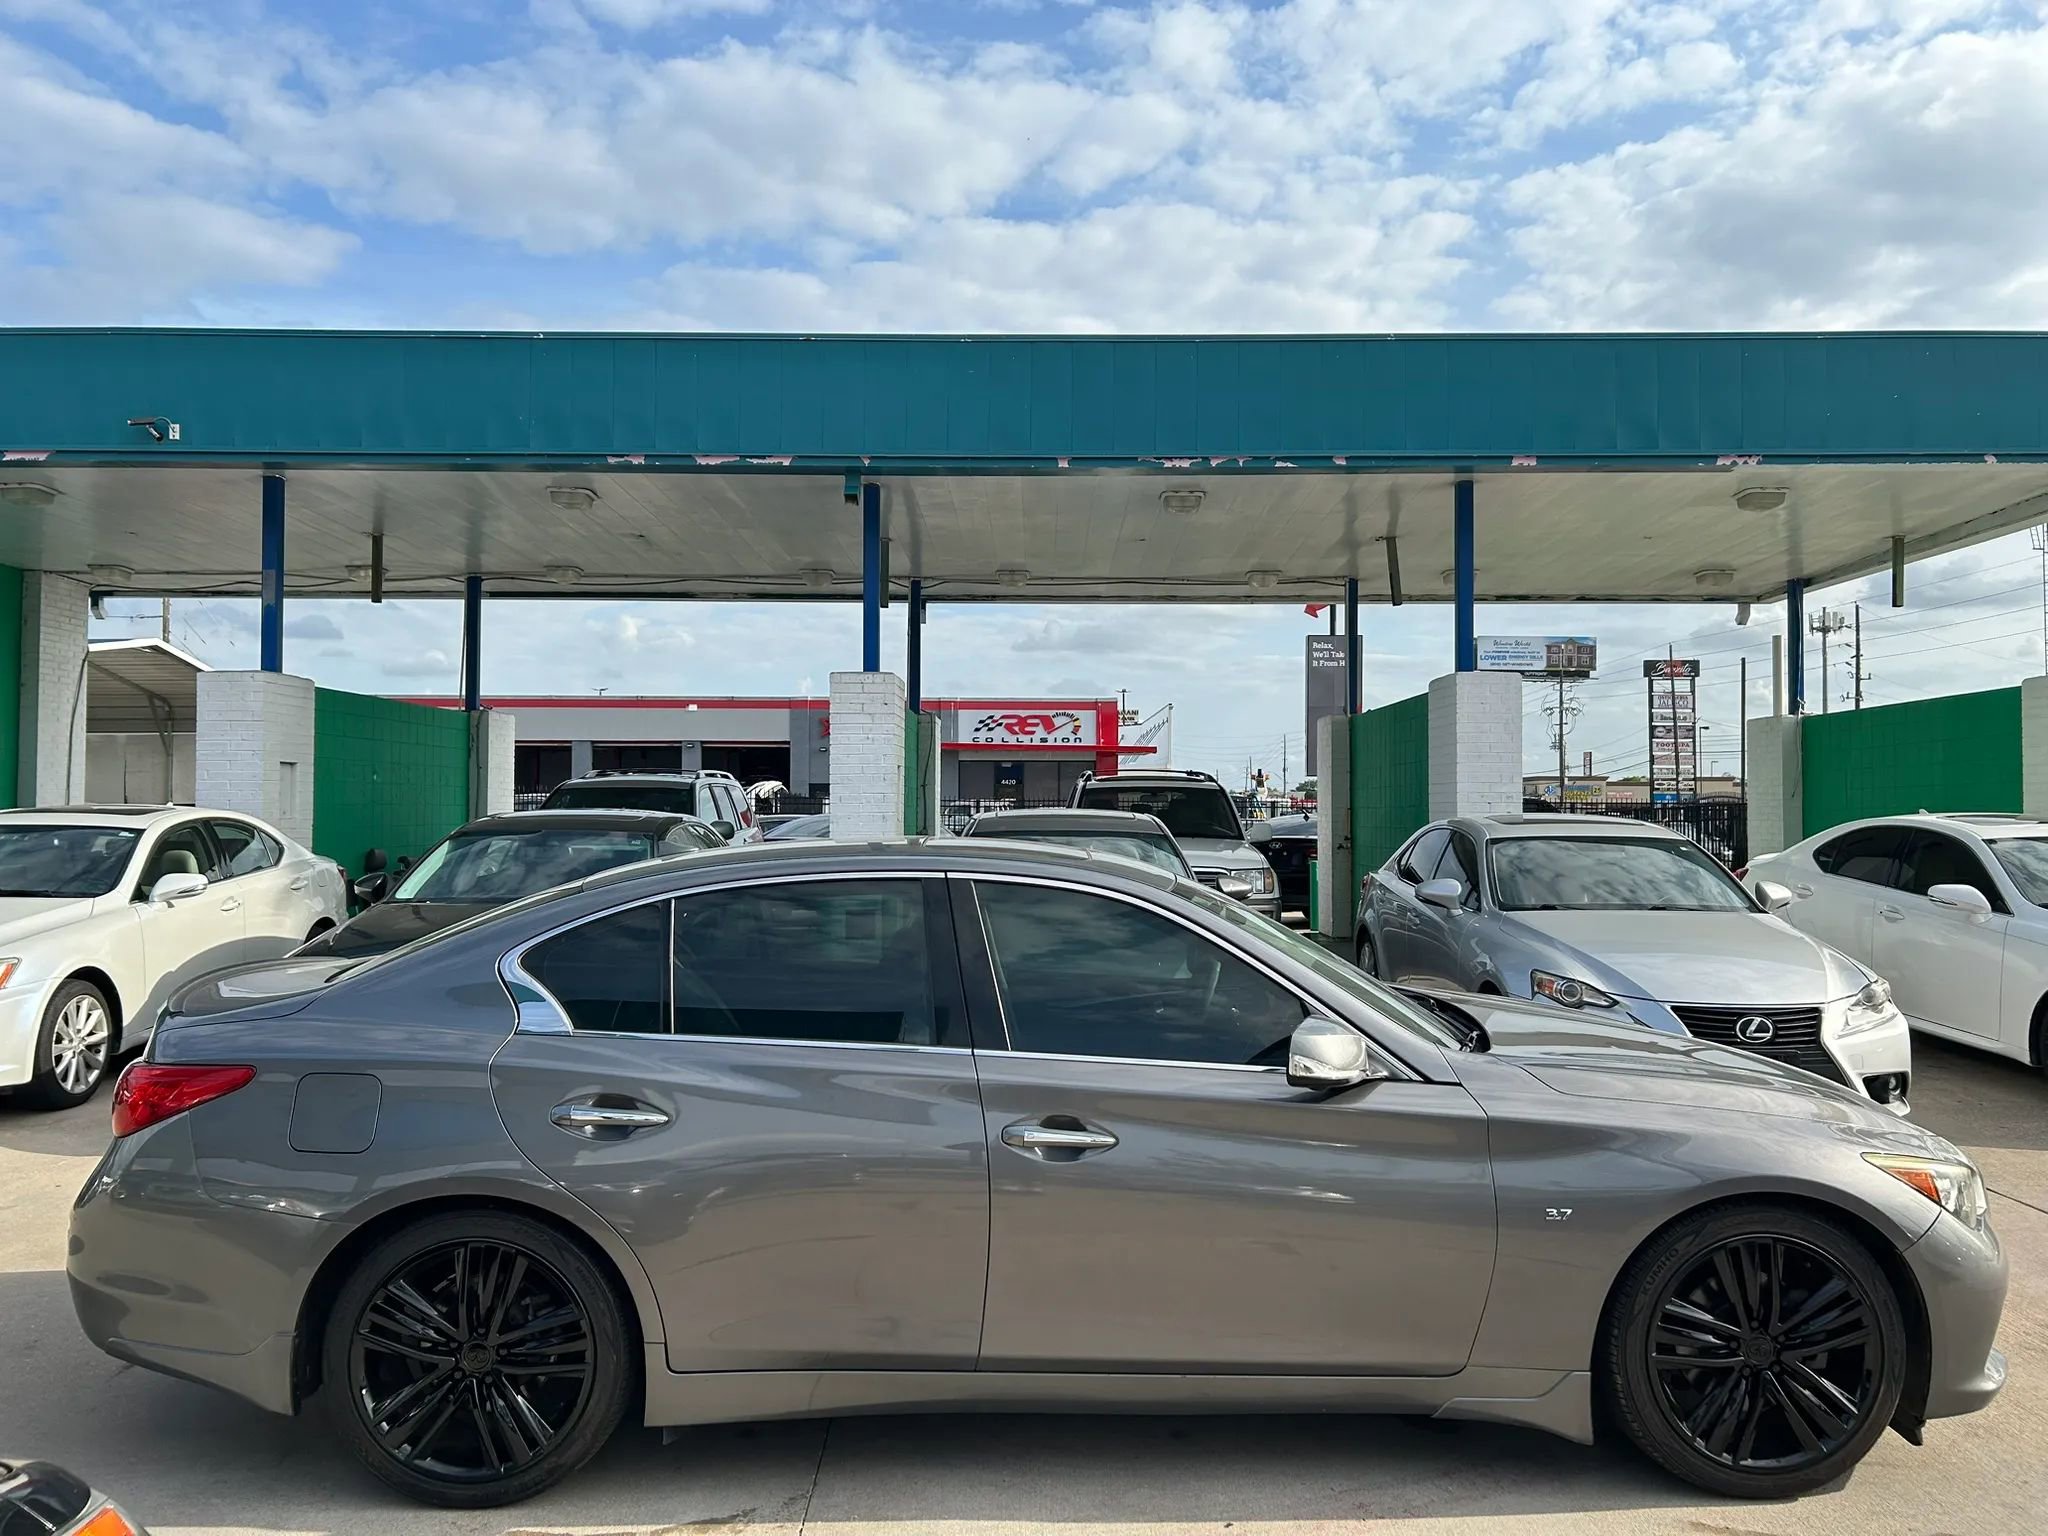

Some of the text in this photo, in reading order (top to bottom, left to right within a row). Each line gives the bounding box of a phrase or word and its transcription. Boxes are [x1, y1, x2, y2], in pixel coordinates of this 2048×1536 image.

[1312, 641, 1334, 650] Relax,
[1000, 715, 1056, 735] REV
[1641, 1248, 1678, 1295] KUMHO
